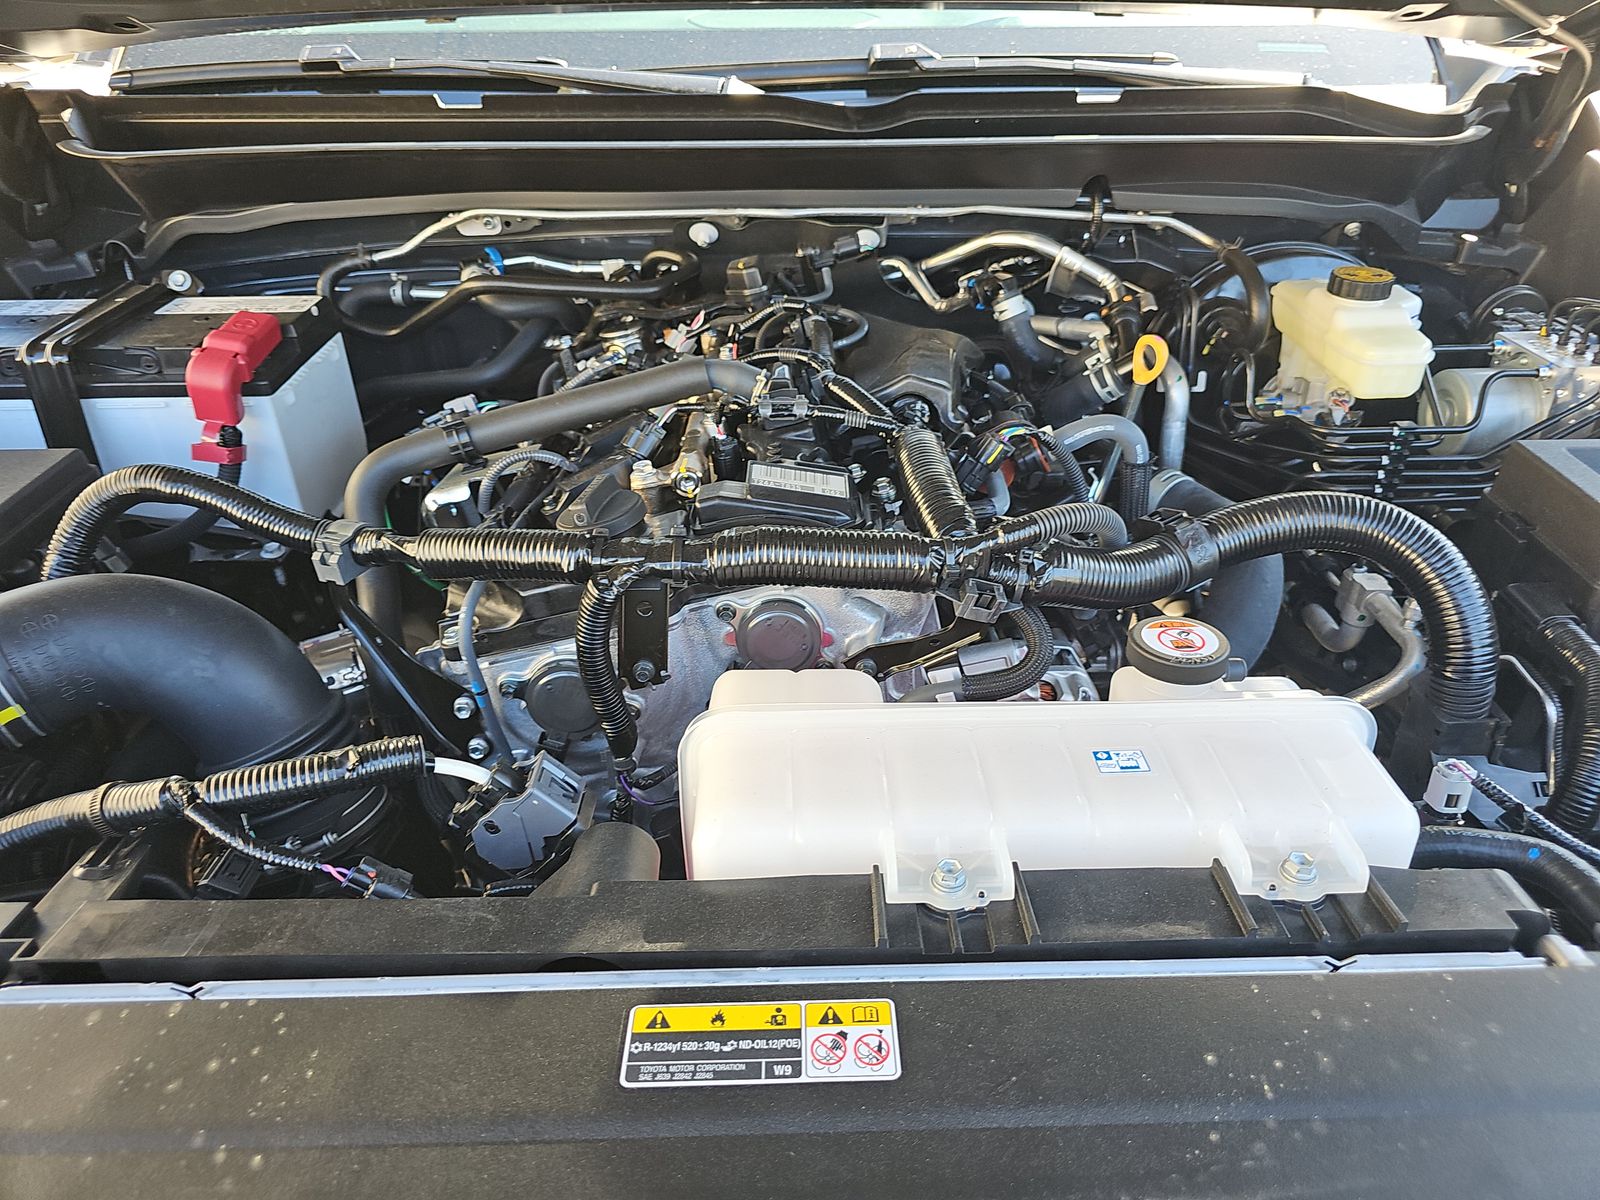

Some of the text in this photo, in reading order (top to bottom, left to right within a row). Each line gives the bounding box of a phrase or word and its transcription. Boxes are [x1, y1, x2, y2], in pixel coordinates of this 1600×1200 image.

[643, 1039, 801, 1054] R-1234yf 520±30g ND-OIL12(POE)
[639, 1065, 667, 1073] TOYOTA
[772, 1065, 793, 1076] W9
[638, 1073, 653, 1081] SAE
